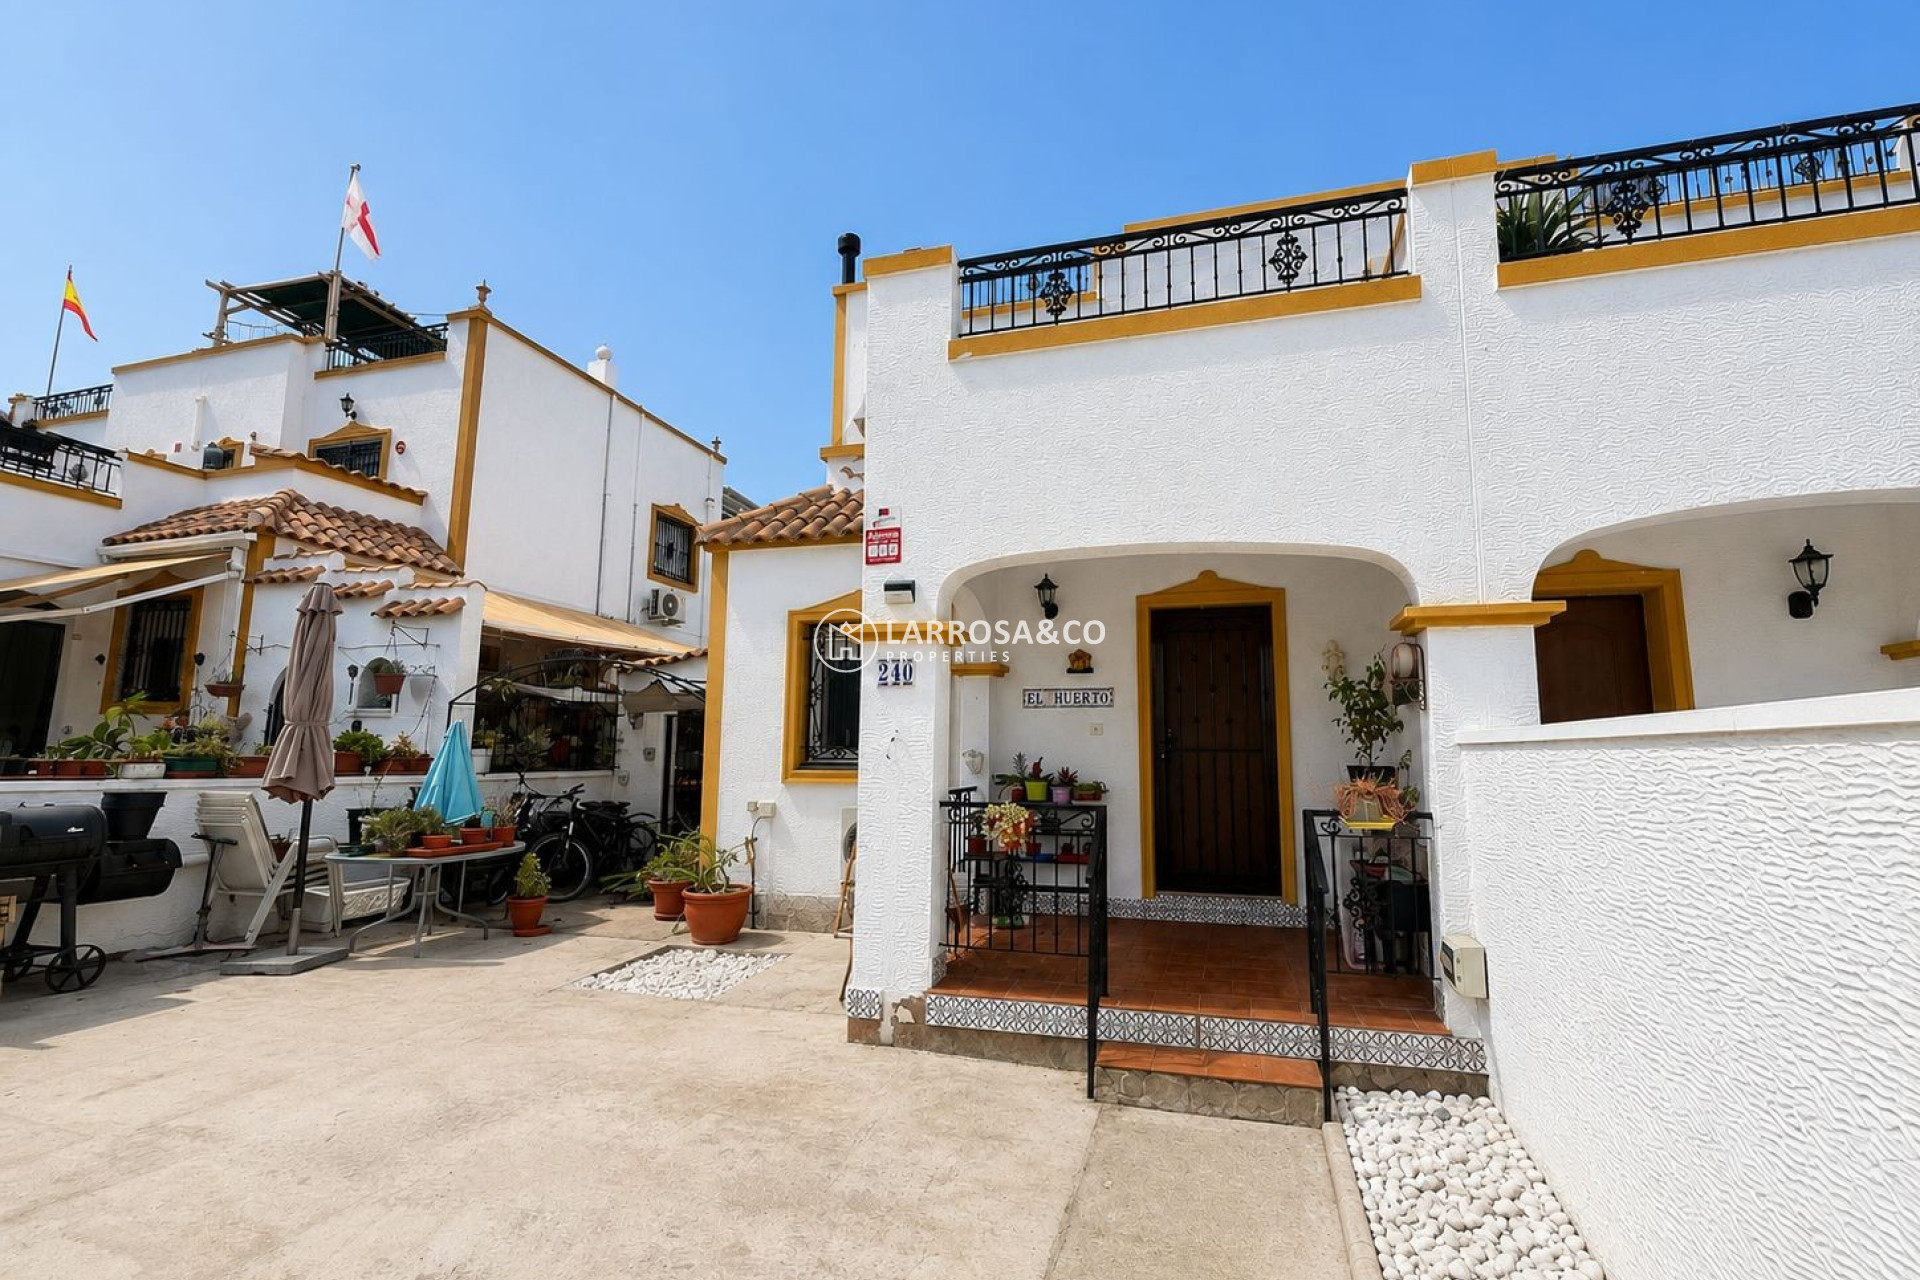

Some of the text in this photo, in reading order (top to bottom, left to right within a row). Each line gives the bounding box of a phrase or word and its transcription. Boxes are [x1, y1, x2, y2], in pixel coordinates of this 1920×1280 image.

[877, 661, 913, 682] 240
[1027, 692, 1109, 705] EL HUERTO
